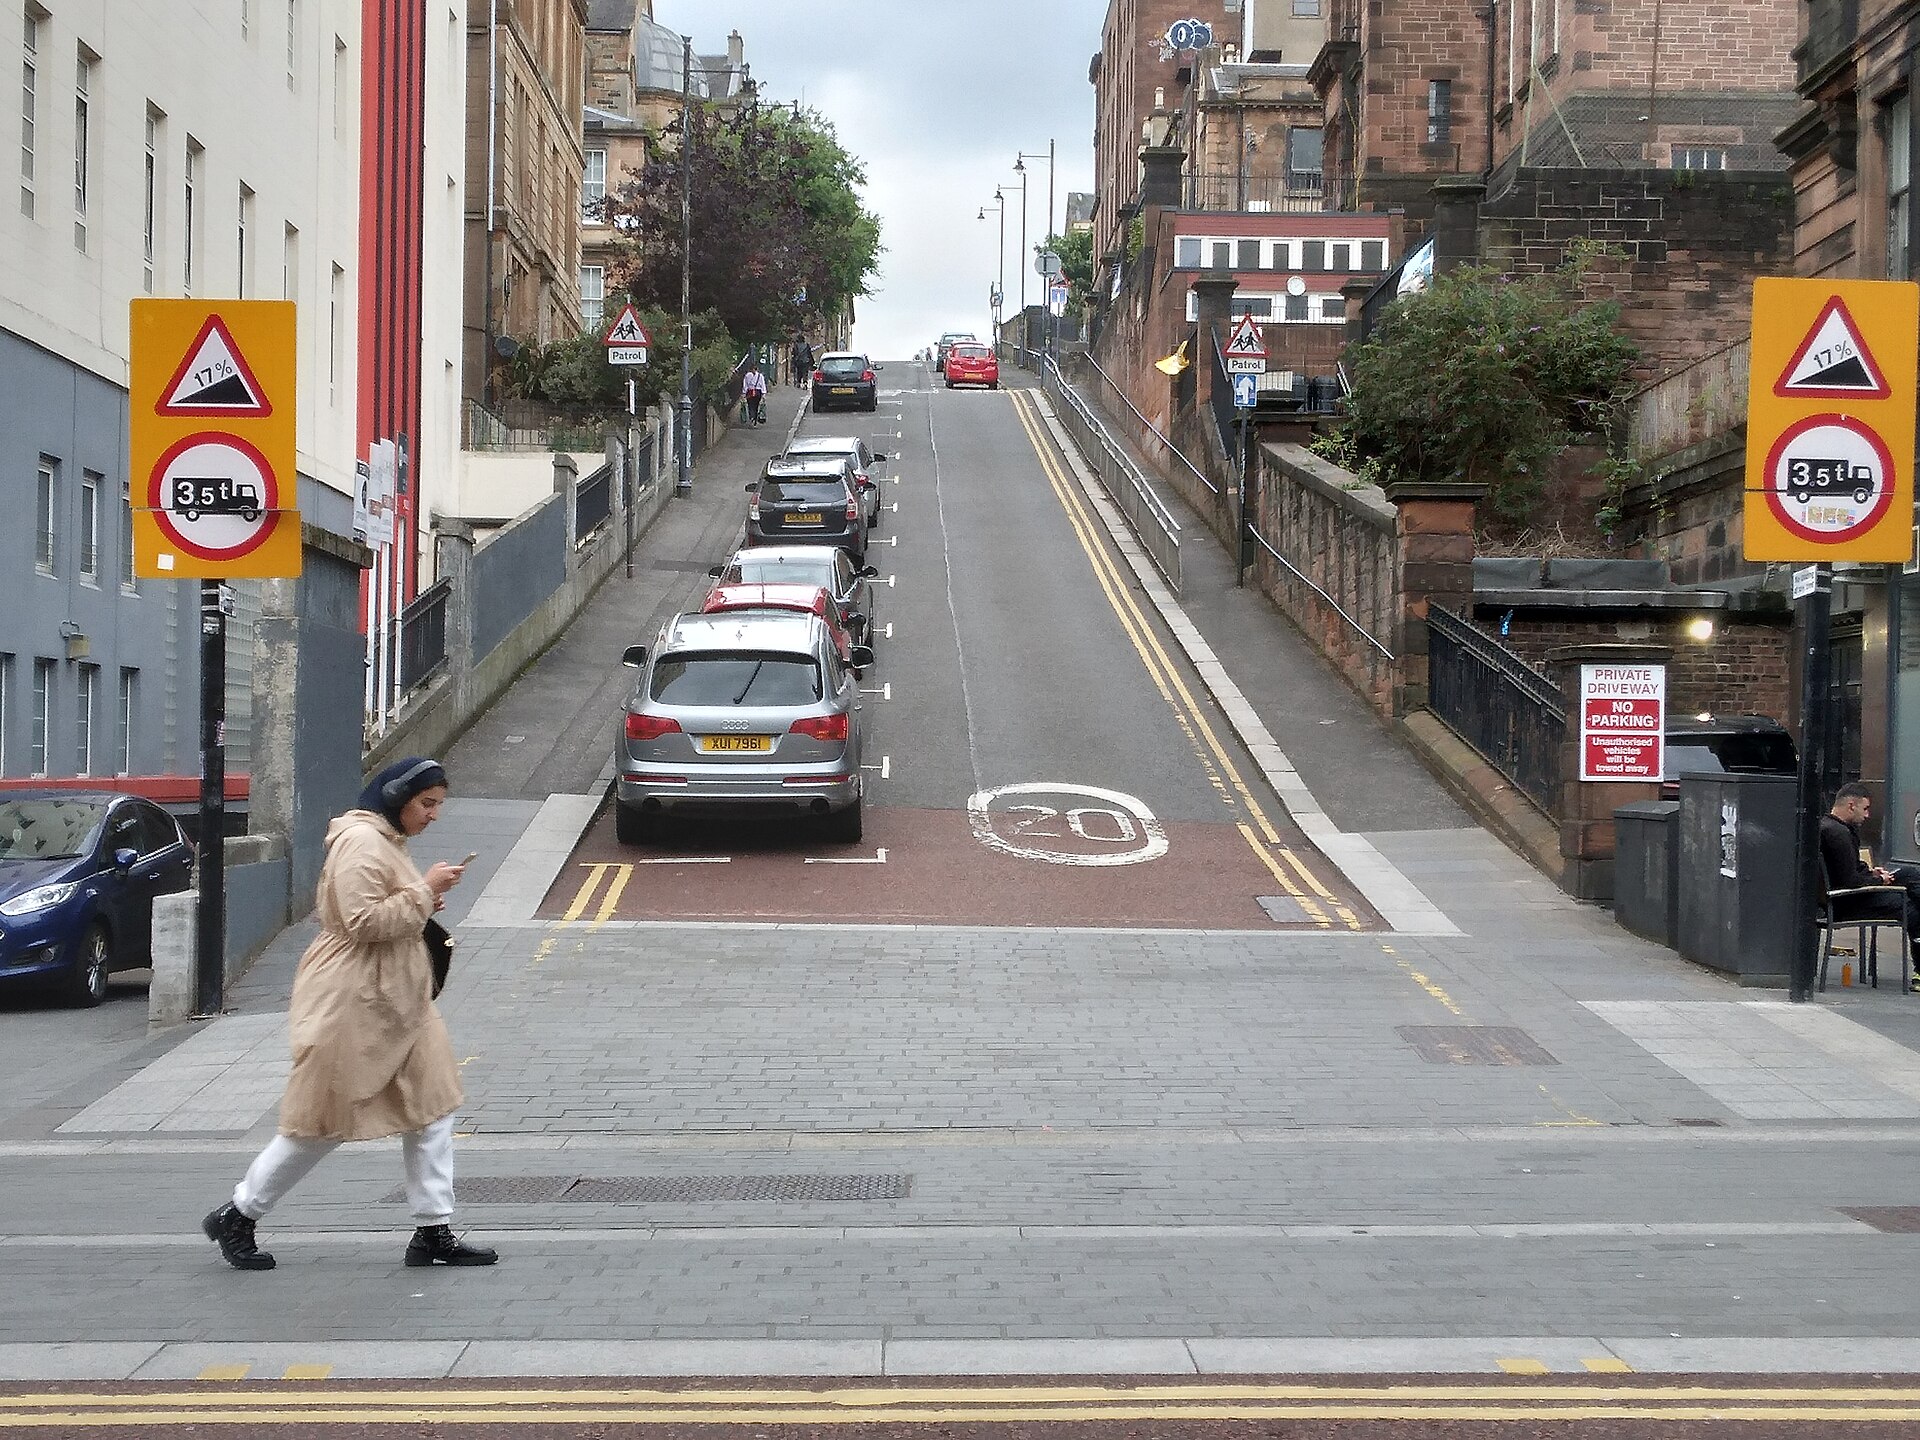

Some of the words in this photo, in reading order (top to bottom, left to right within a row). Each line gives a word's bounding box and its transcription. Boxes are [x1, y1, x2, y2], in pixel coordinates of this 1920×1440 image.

[612, 351, 642, 361] Patrol
[1813, 340, 1853, 369] 17%
[1231, 360, 1262, 370] Patrol
[193, 359, 233, 388] 17%
[1594, 669, 1652, 681] PRIVATE
[1587, 683, 1659, 695] DRIVEWAY
[1611, 701, 1634, 714] NO
[1591, 714, 1655, 727] PARKING
[711, 737, 731, 749] XUI
[1592, 737, 1653, 747] Unauthorised
[1603, 746, 1642, 755] vehicles
[1606, 755, 1622, 764] will
[1624, 755, 1636, 764] be
[1595, 764, 1624, 773] towed
[1625, 765, 1649, 774] away
[1007, 805, 1137, 843] 20
